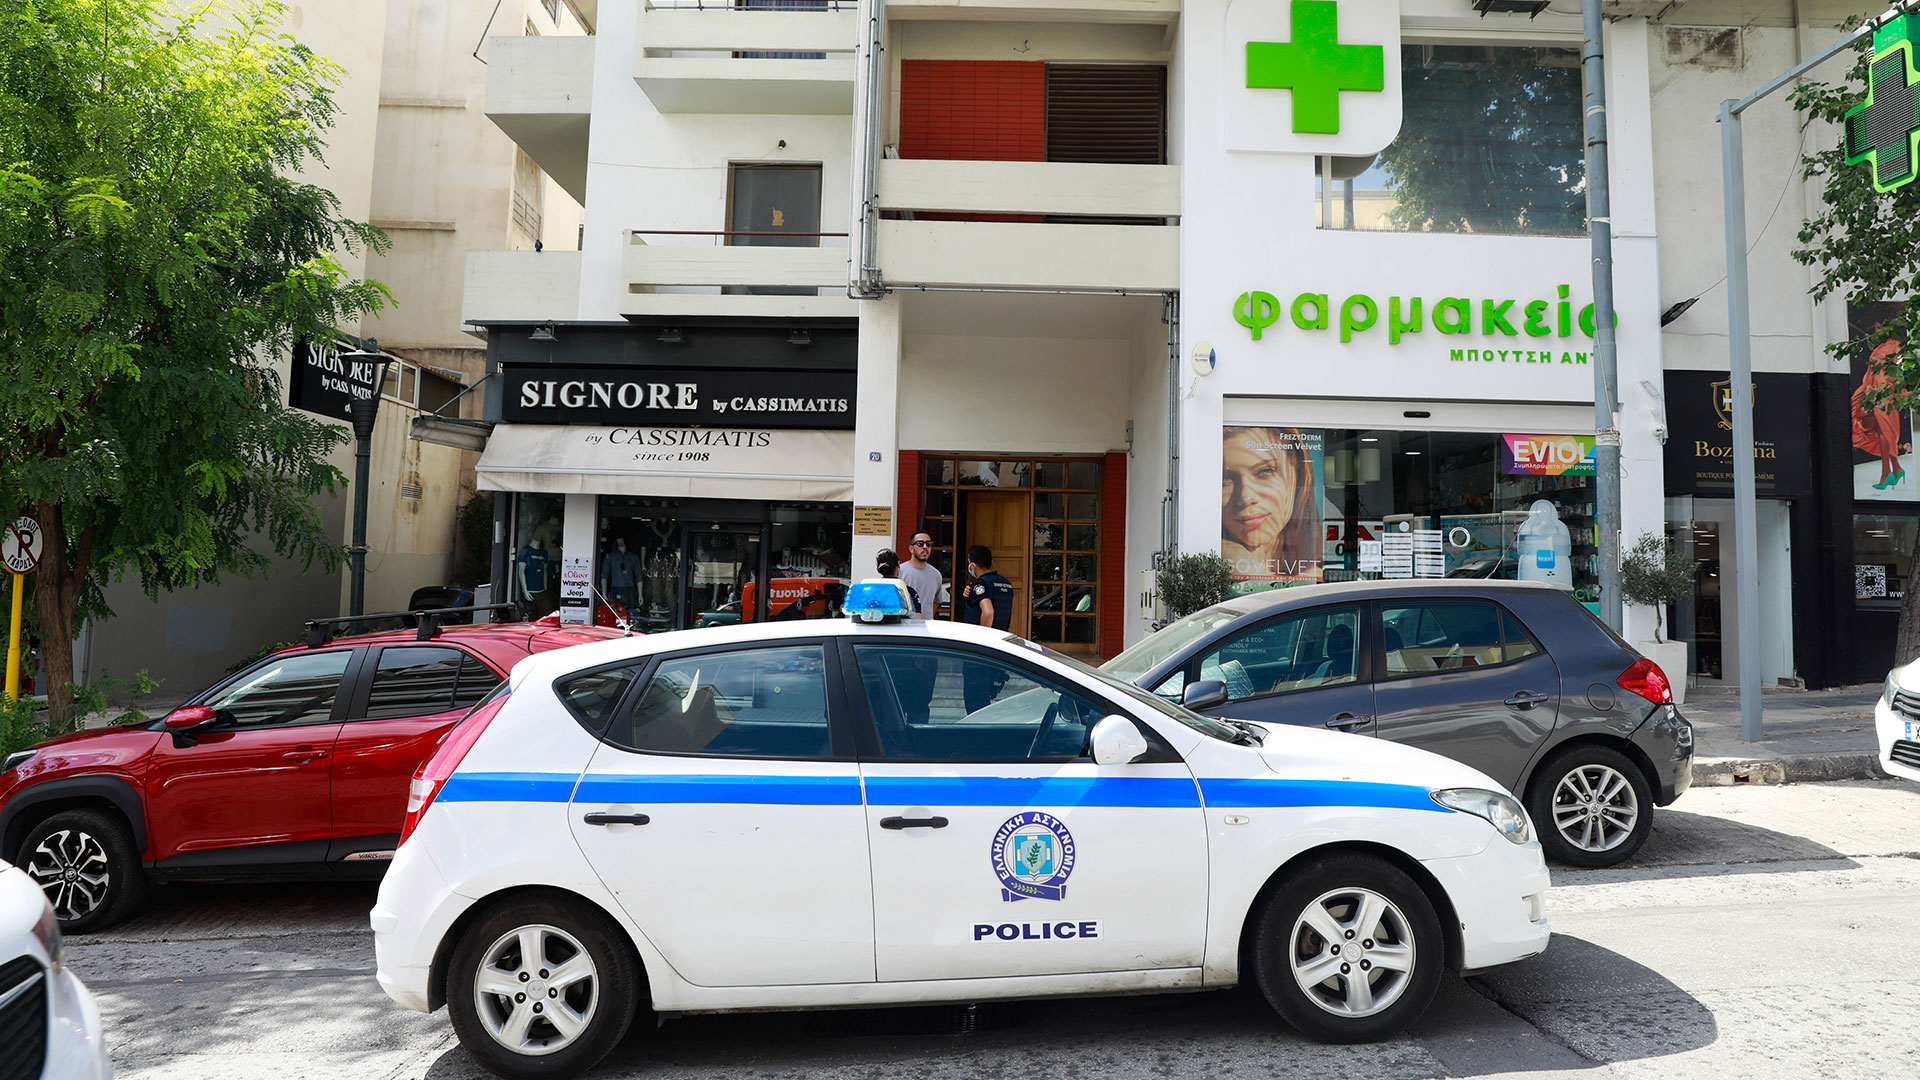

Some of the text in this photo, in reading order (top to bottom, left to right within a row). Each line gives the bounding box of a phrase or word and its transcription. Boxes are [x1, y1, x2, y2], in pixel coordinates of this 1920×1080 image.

[1450, 349, 1594, 365] ΜΠΟΥΤΣΗ ΑΝ
[322, 375, 372, 400] by CASSMATIS
[520, 380, 848, 413] SIGNORE by CASSIMATIS
[585, 428, 771, 447] by CASSIMATIS
[1264, 442, 1293, 450] Screen
[1295, 442, 1322, 450] Velvet
[632, 451, 710, 462] since 1908
[870, 452, 880, 461] 20
[1513, 440, 1595, 464] EVIOL
[1694, 440, 1777, 459] Bozna
[562, 580, 590, 589] Wrangler
[567, 589, 585, 597] Jeep
[993, 813, 1074, 881] ΕΛΛΗΝΙΚΗ ΑΣΤΥΝΟΜΙΑ
[973, 921, 1098, 941] POLICE
